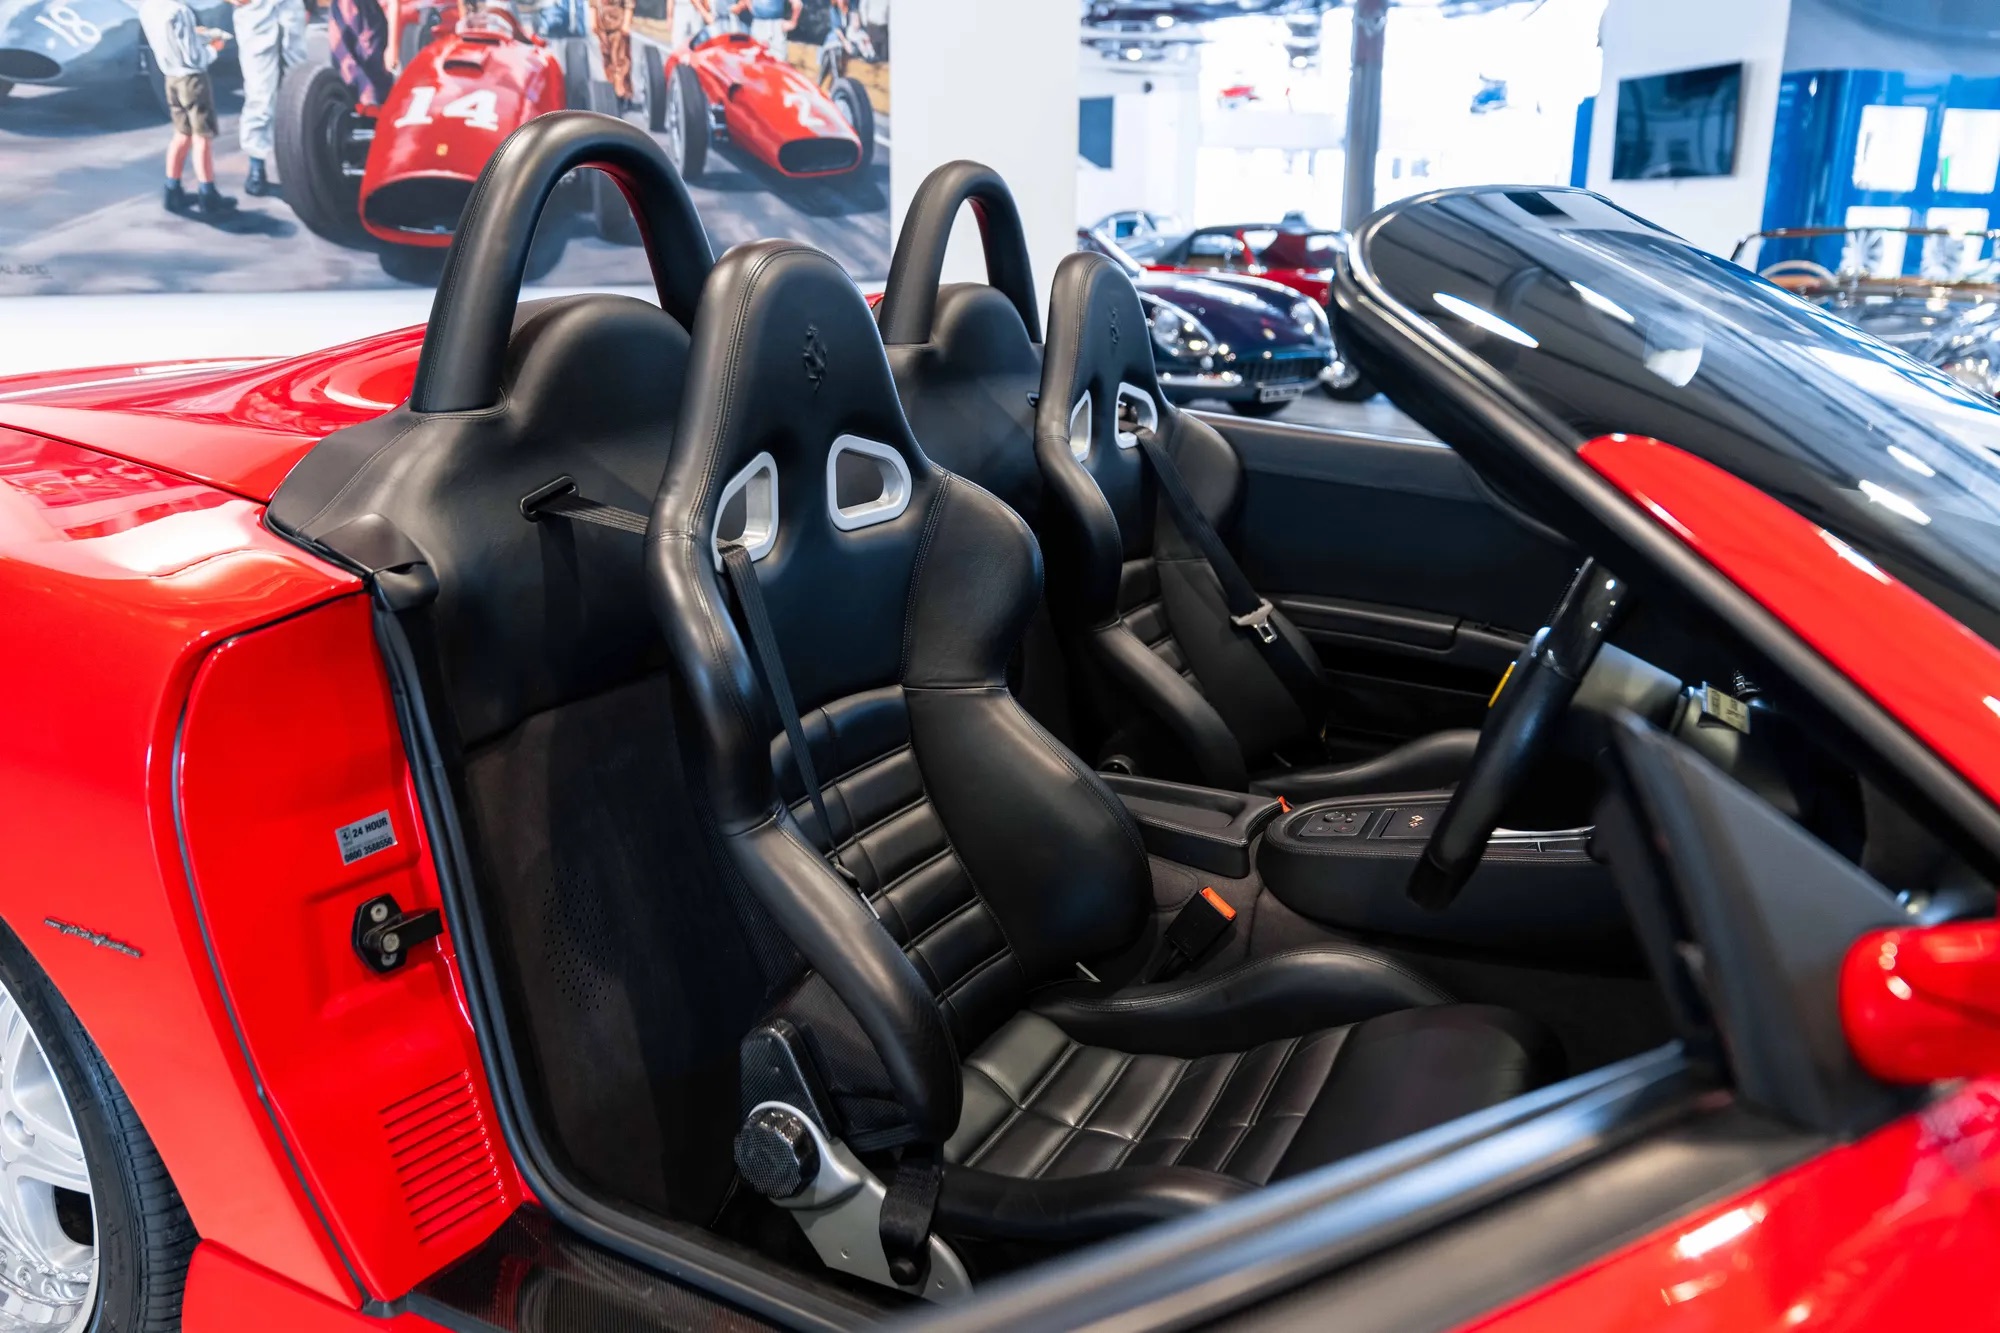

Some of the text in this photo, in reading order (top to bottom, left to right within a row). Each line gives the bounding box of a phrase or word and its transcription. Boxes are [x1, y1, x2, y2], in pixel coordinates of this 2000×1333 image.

[34, 6, 102, 49] 18
[394, 86, 499, 132] 14
[352, 817, 388, 838] 24 HOUR
[344, 848, 362, 863] 0800
